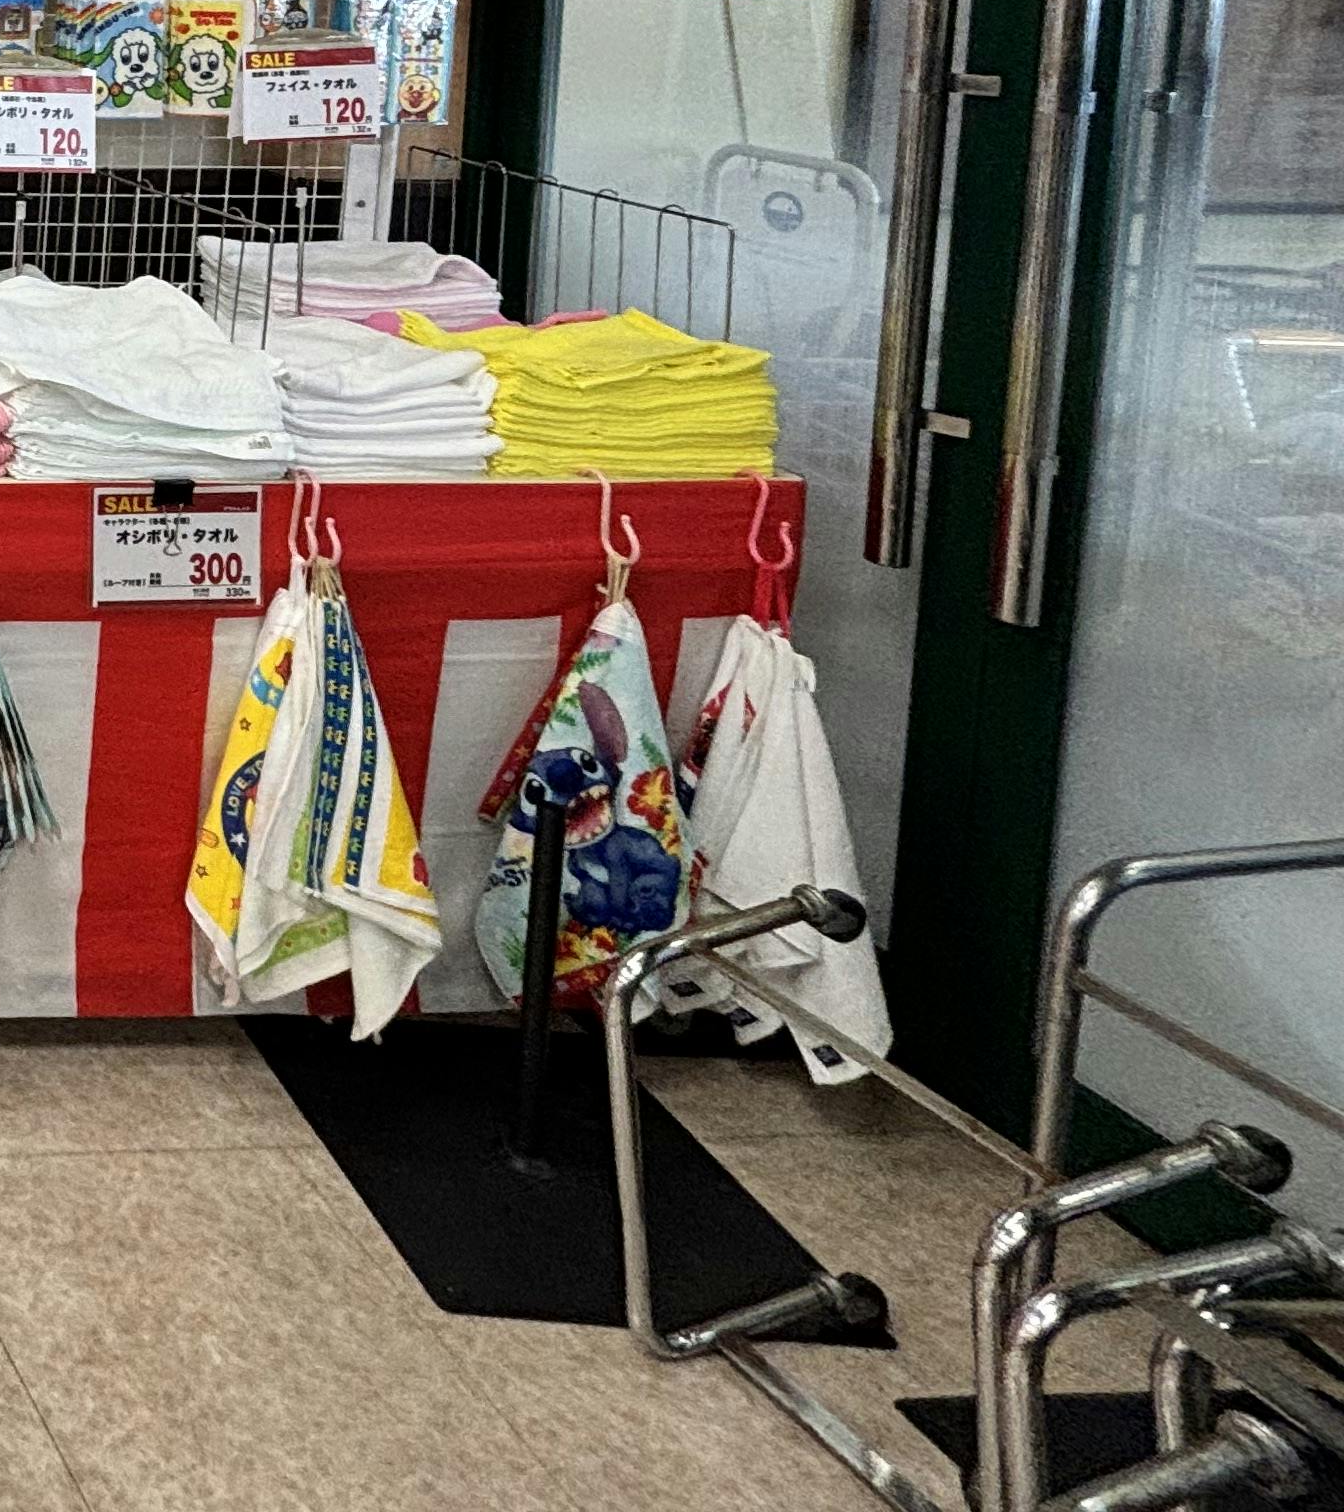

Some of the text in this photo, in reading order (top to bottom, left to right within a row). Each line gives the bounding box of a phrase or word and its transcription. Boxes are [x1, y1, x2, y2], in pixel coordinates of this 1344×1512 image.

[250, 52, 296, 68] SALE
[266, 78, 357, 93] フェイス・タオル
[104, 495, 159, 513] SALE
[226, 776, 251, 816] LOVE
